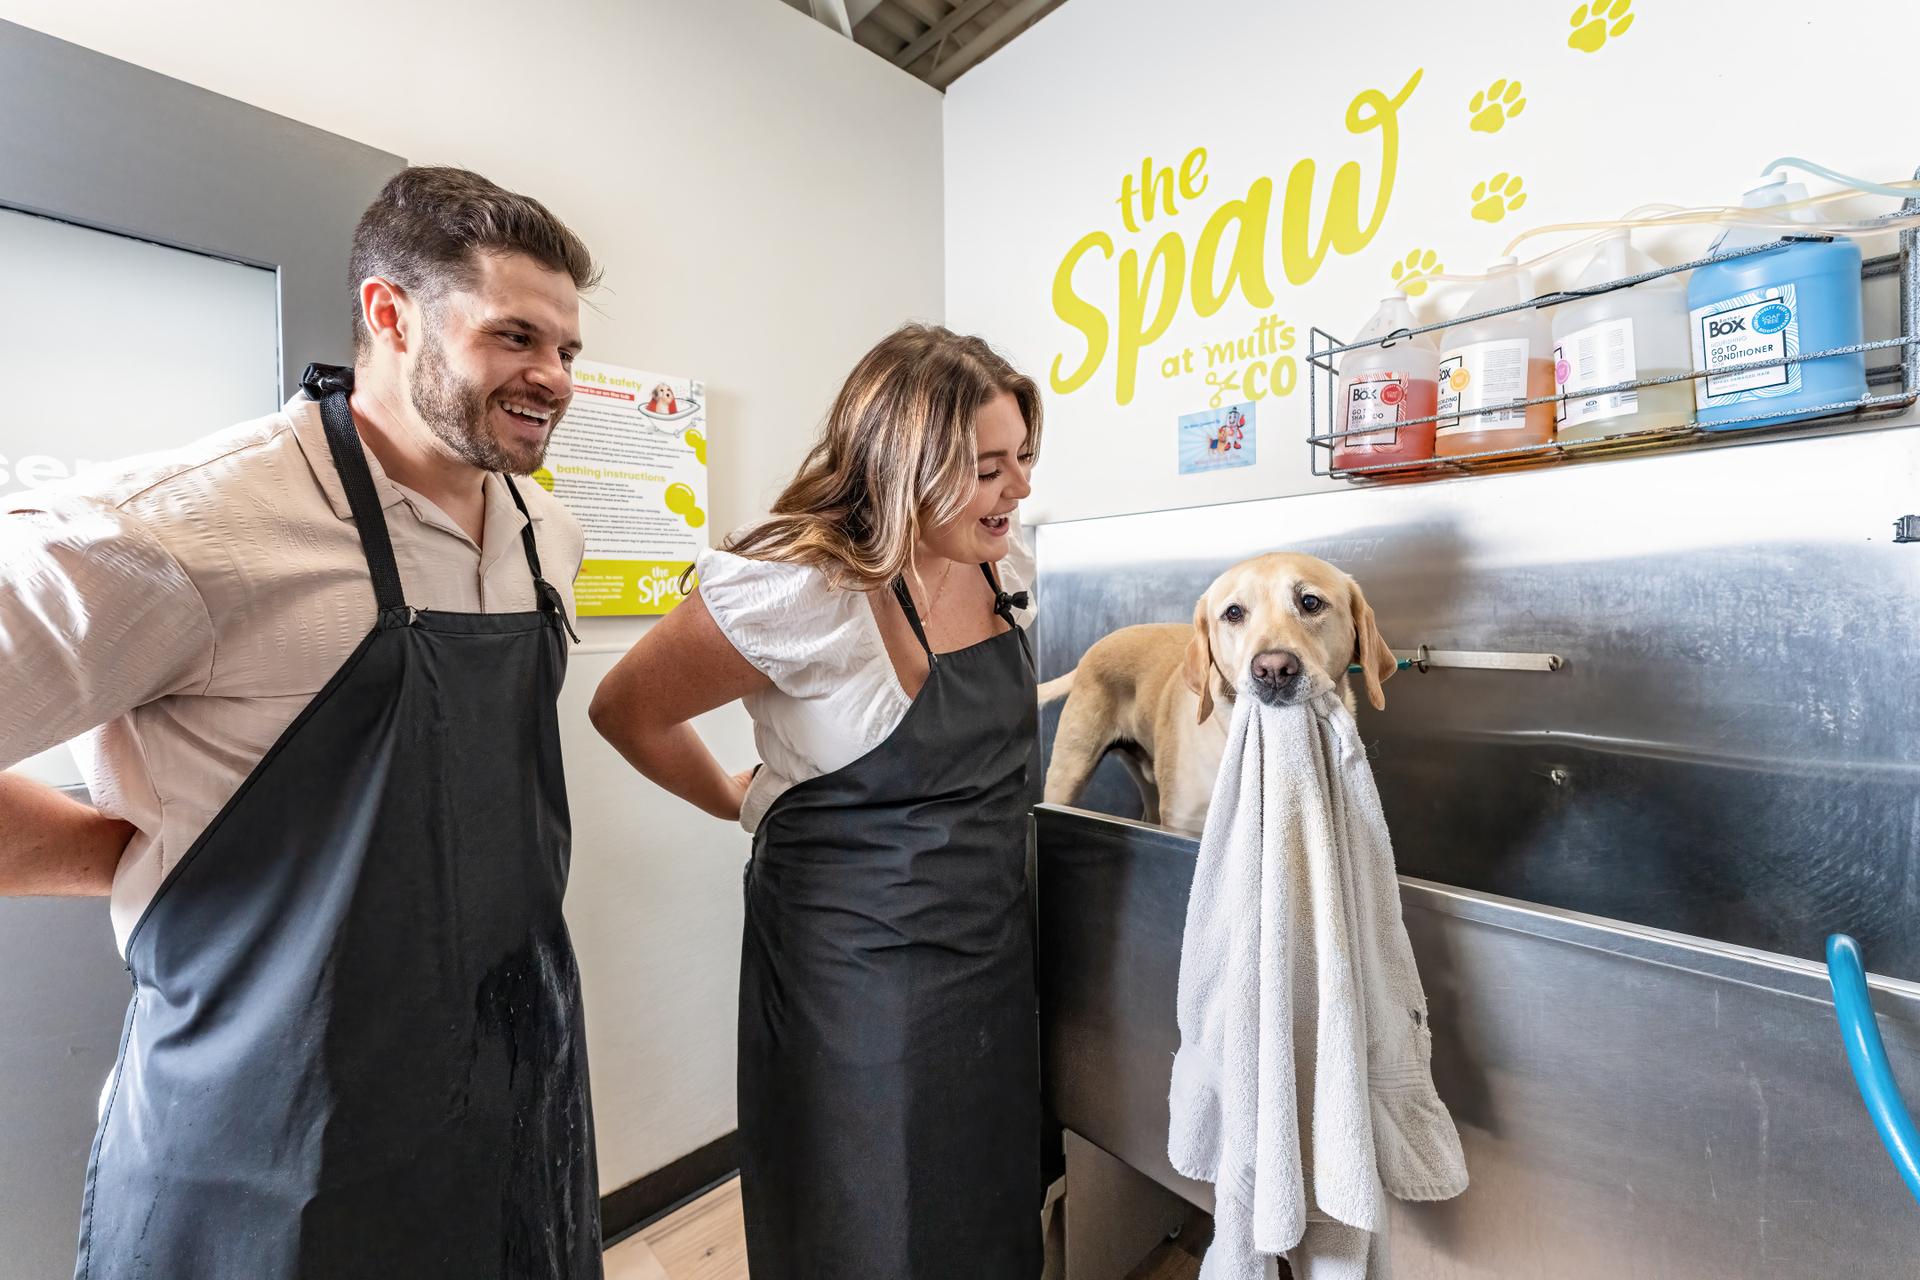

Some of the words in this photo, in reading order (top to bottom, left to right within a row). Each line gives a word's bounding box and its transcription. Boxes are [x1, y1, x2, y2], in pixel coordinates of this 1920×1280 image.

[1115, 147, 1209, 233] the
[1049, 68, 1424, 406] Spaw
[1709, 317, 1746, 338] BOX
[1161, 348, 1194, 379] at
[1203, 314, 1296, 367] mutts
[1711, 347, 1723, 356] GO
[1726, 344, 1737, 352] TO
[1711, 344, 1774, 363] CONDITIONER
[575, 370, 595, 382] tips
[610, 377, 641, 391] safety
[556, 464, 601, 479] bathing
[603, 468, 666, 482] instructions
[652, 566, 669, 578] the
